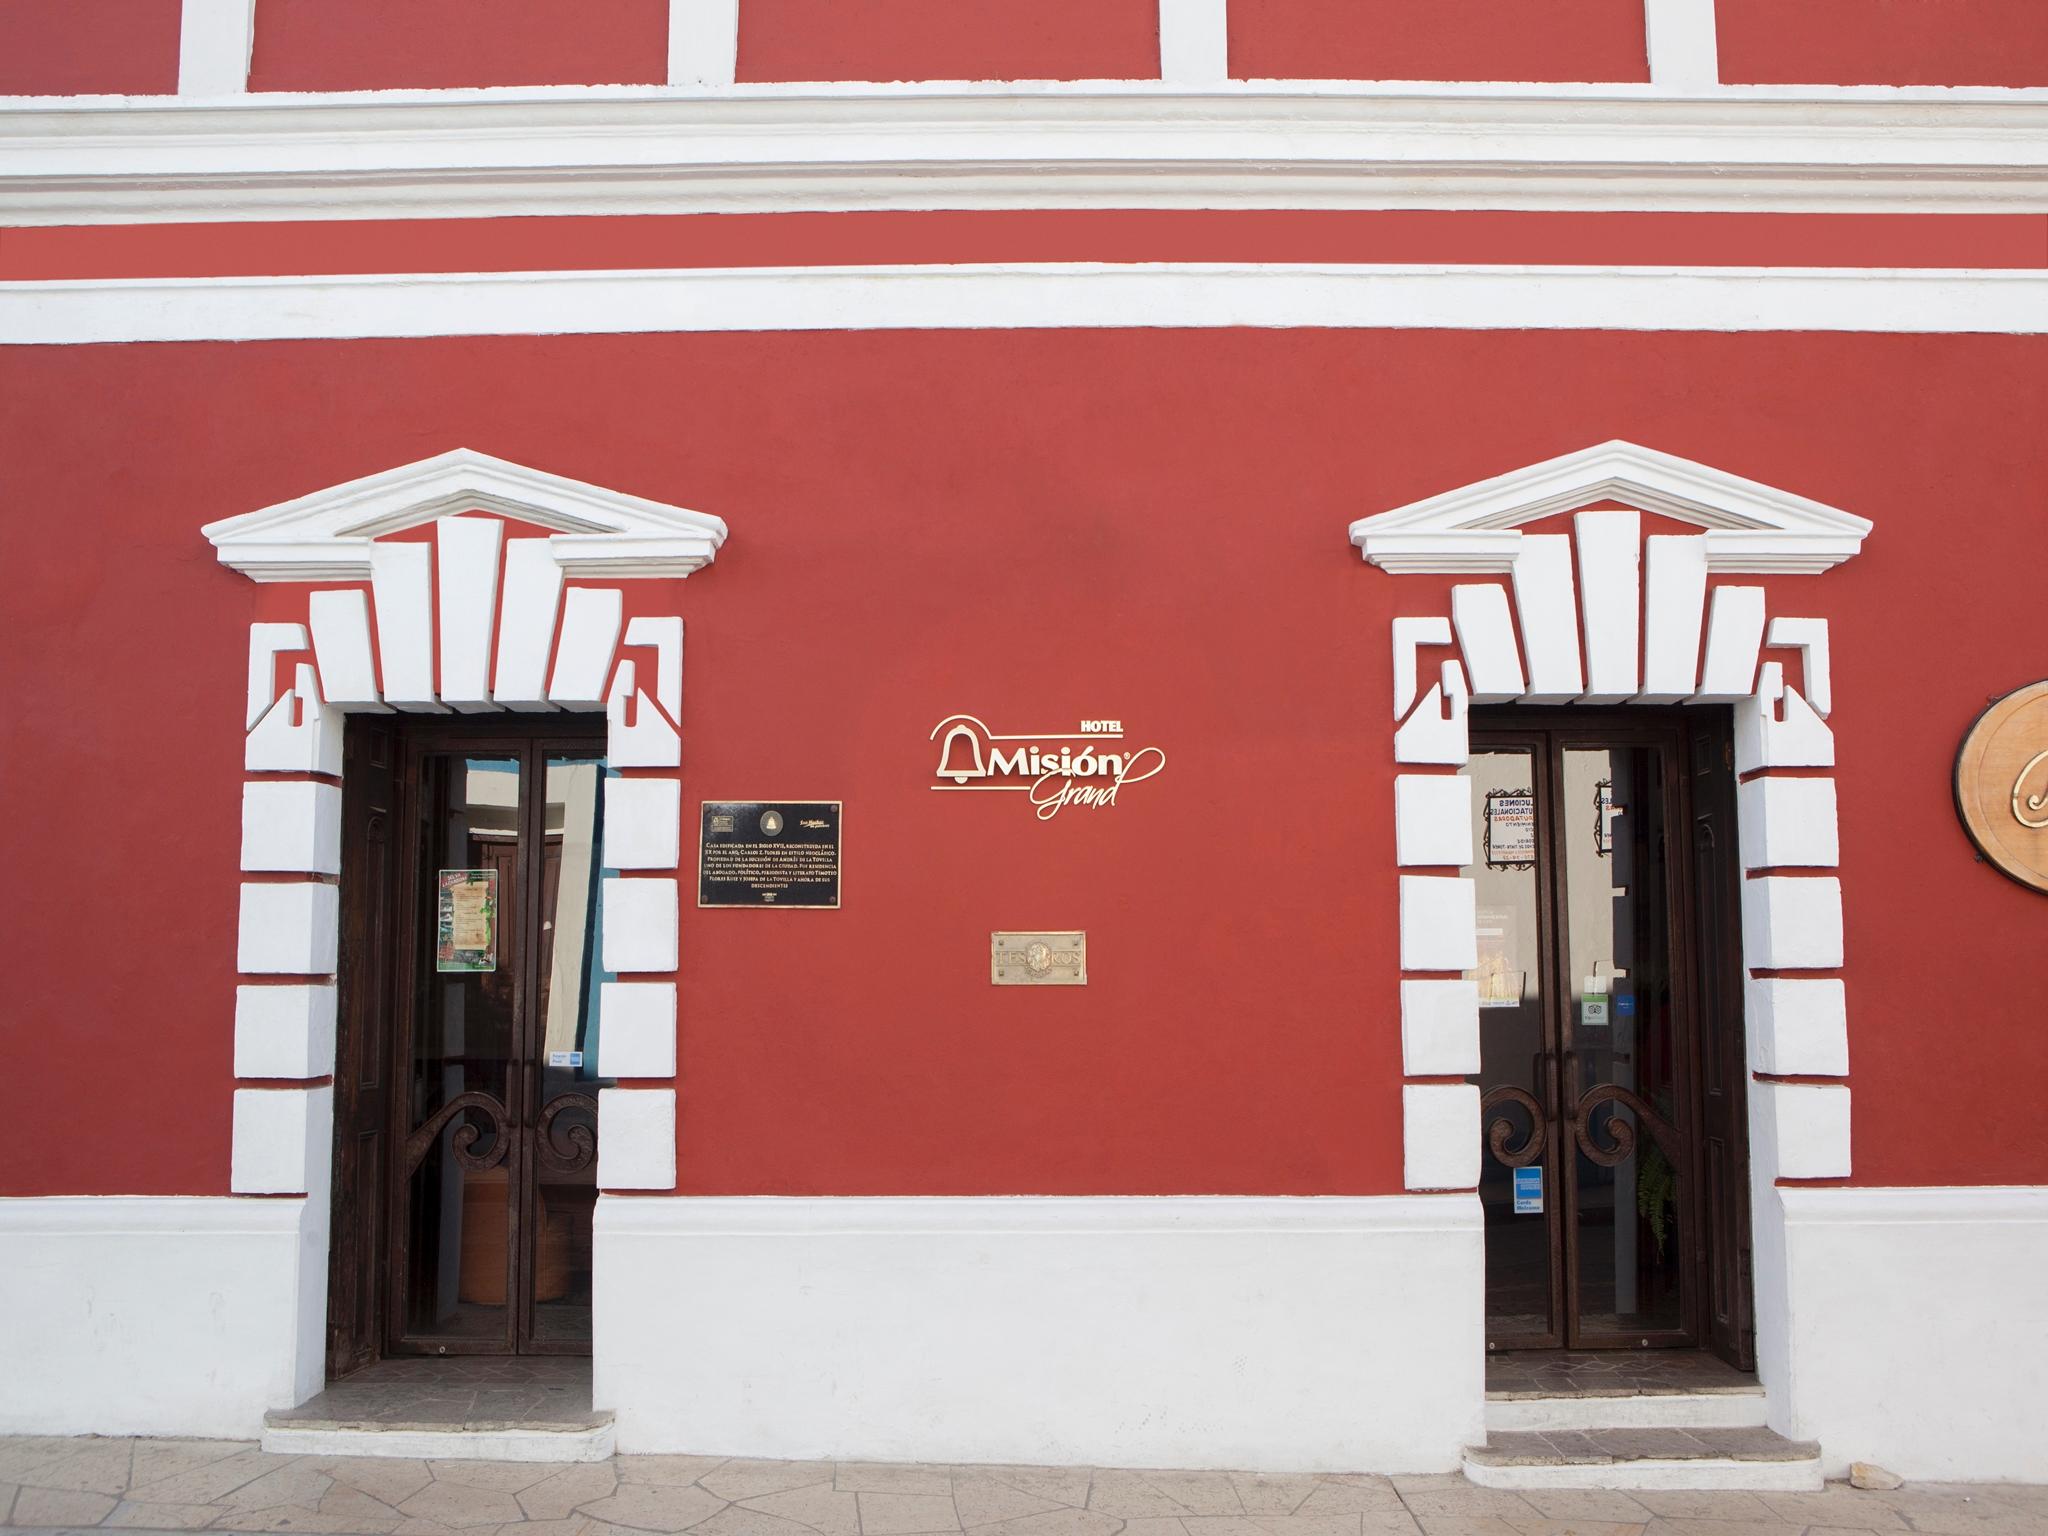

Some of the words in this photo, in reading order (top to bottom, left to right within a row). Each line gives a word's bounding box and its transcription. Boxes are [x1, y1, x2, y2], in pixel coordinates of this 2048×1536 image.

[1080, 720, 1124, 733] HOTEL
[986, 745, 1123, 777] Misión
[1029, 746, 1166, 821] Grand
